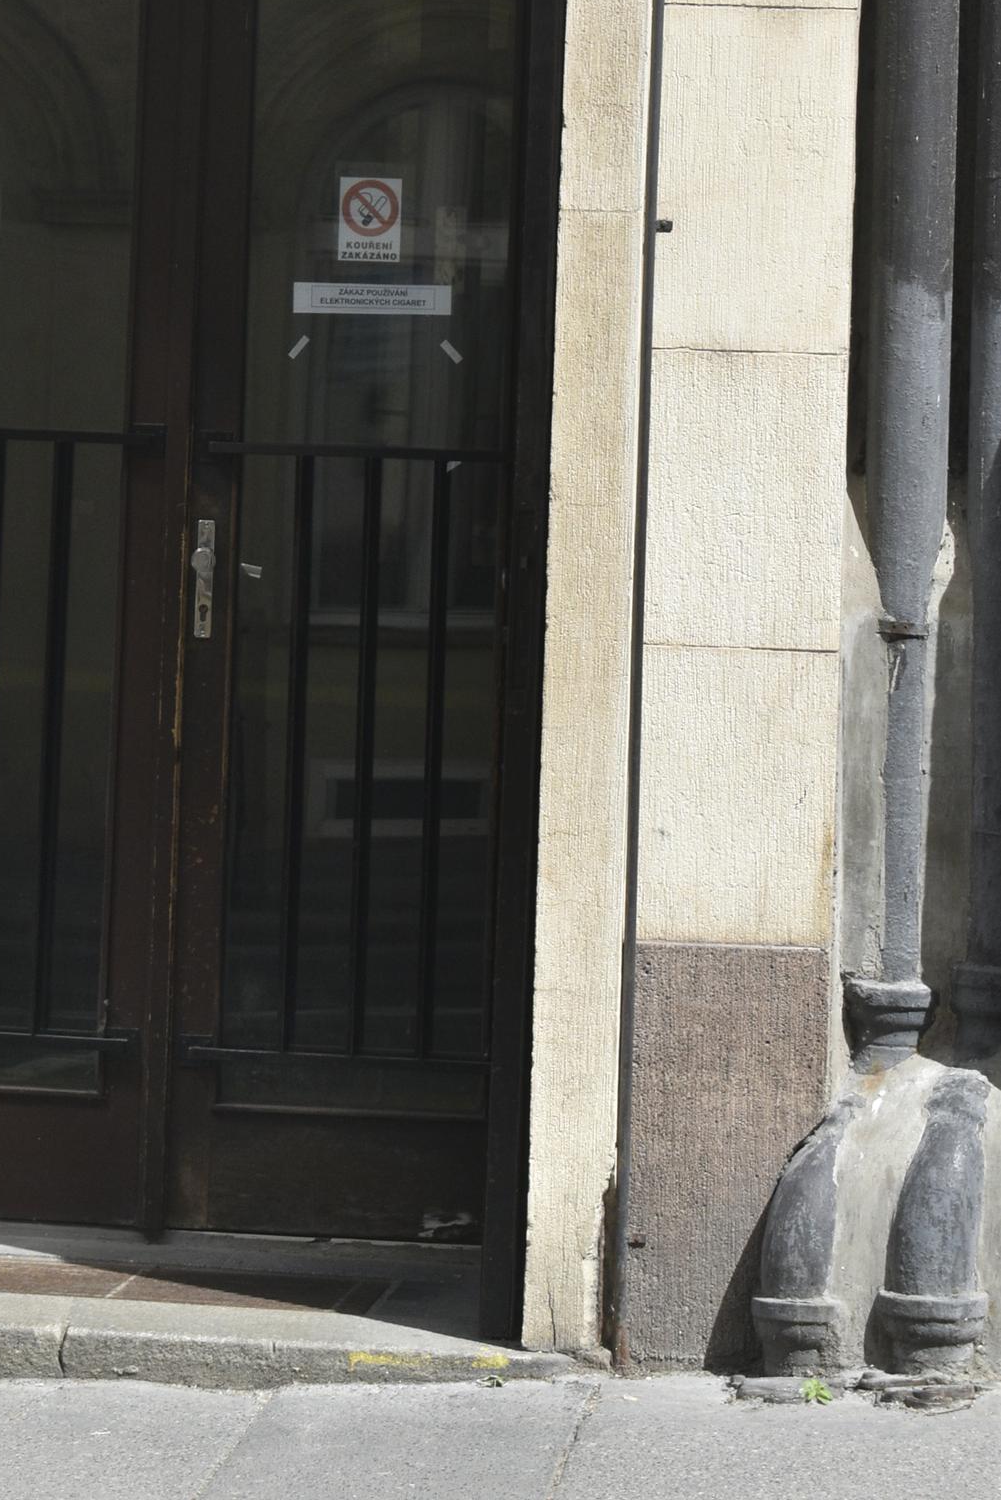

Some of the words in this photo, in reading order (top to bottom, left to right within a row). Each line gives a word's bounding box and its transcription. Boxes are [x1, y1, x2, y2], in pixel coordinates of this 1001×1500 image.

[346, 240, 393, 250] KOUŘENÍ
[341, 251, 398, 261] ZAKÁZÁNO
[320, 297, 391, 306] ELEKTRONICKÝCH
[392, 299, 426, 307] CIGARET
